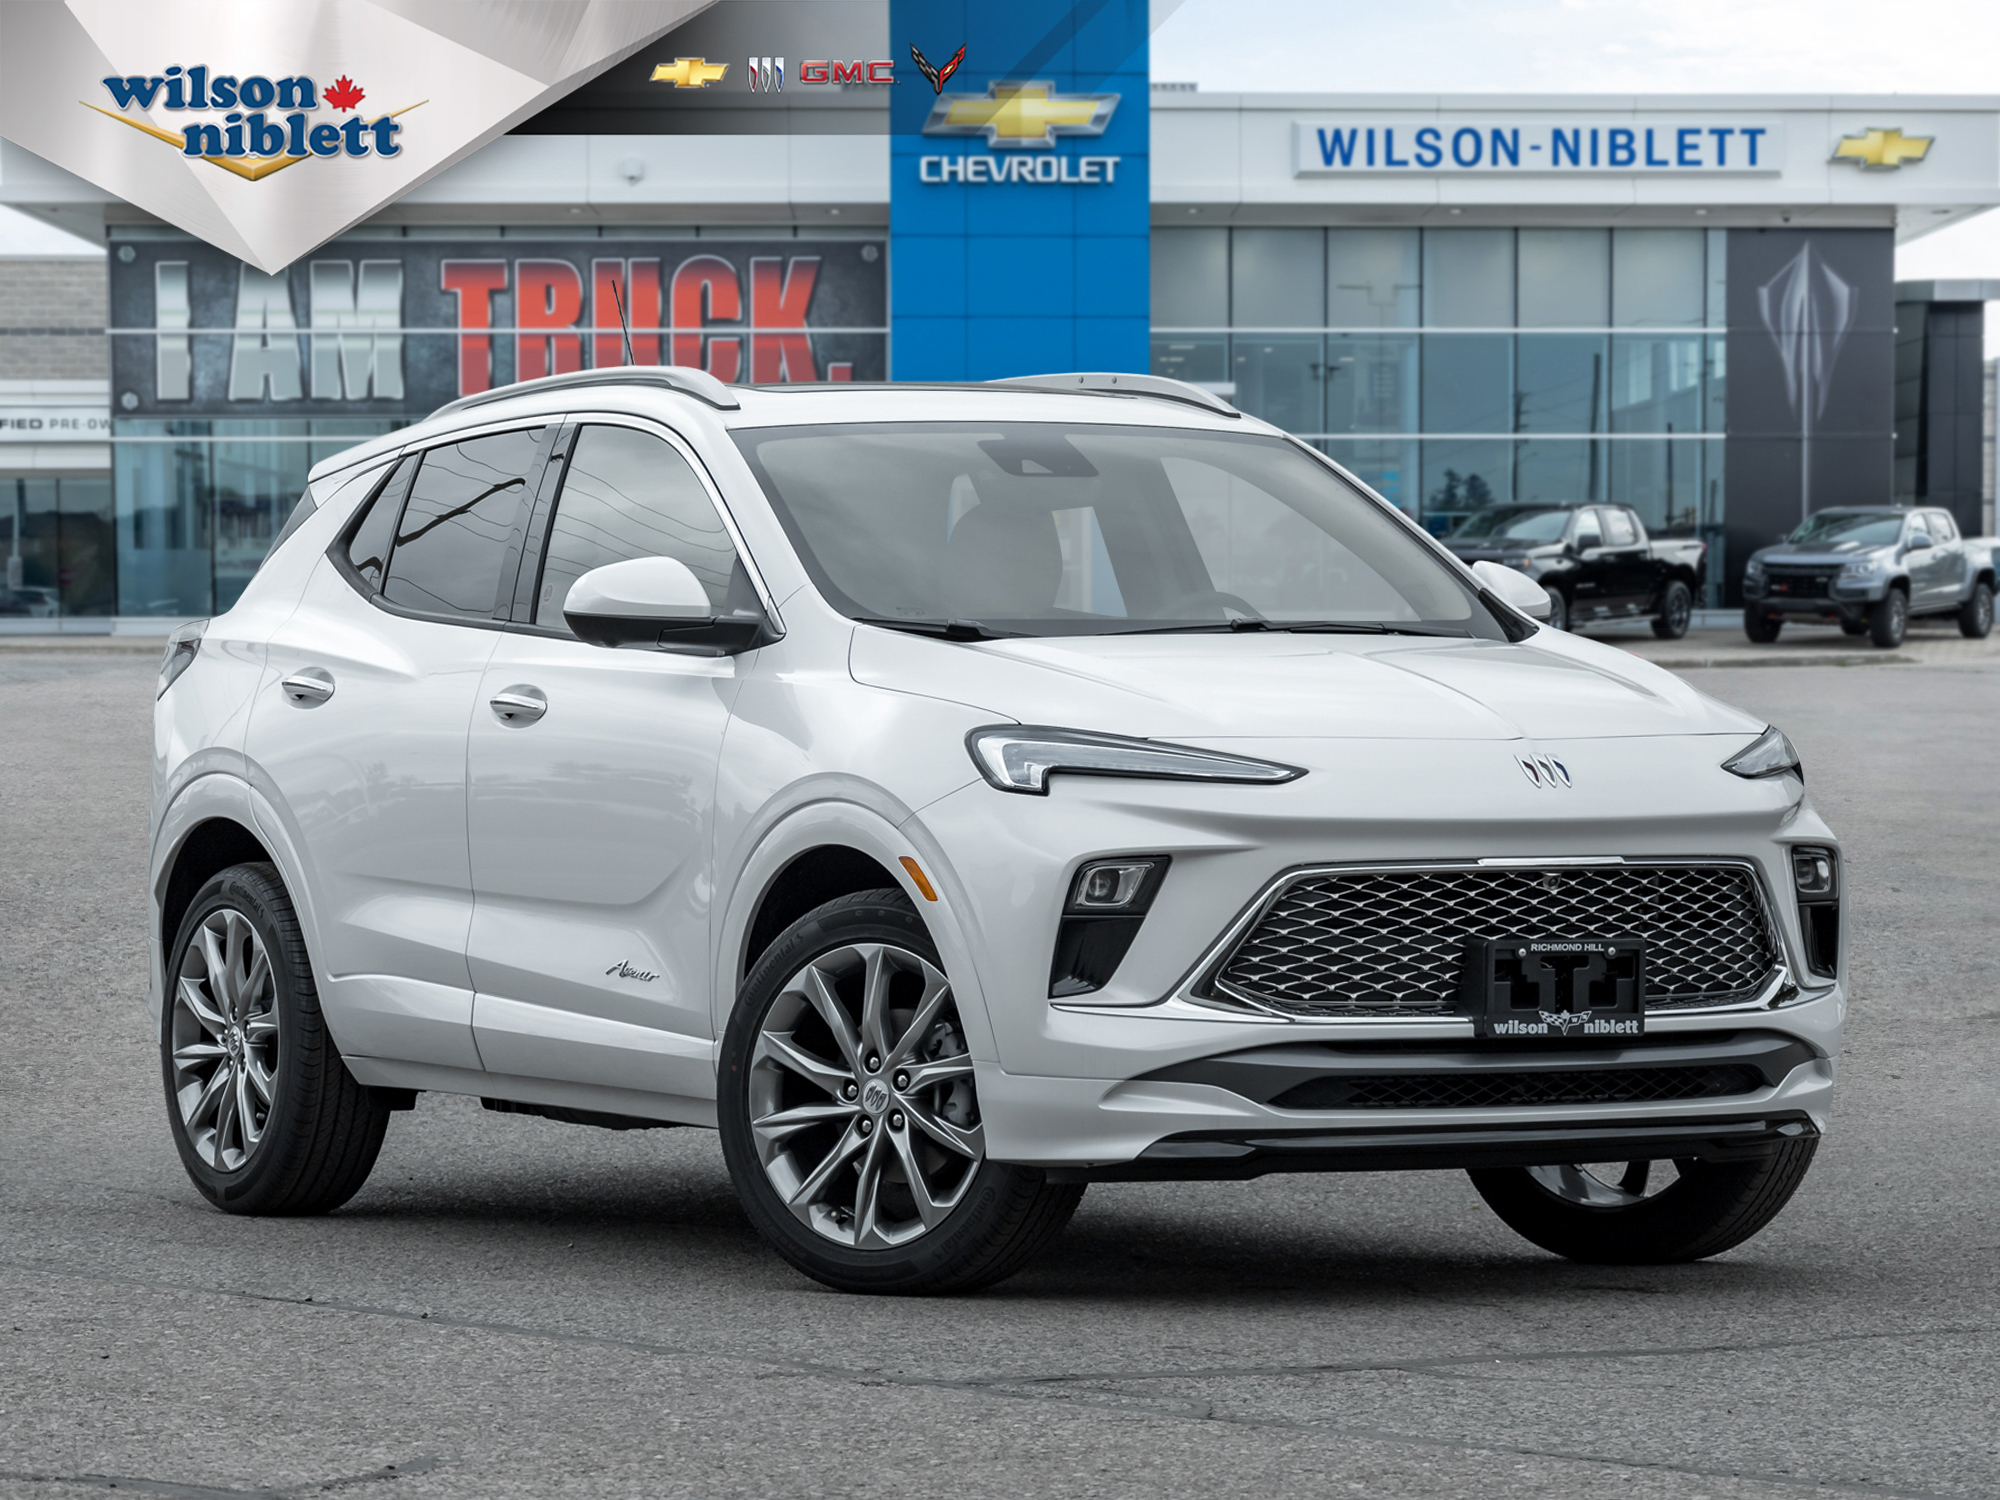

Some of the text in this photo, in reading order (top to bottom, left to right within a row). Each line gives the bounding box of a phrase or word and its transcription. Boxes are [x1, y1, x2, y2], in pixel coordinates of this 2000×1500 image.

[919, 155, 1121, 184] CHEVROLET
[155, 262, 190, 400] I
[228, 259, 404, 400] AM
[1530, 943, 1605, 952] RICHMOND HILL
[745, 938, 795, 1006] Continental
[1493, 1018, 1639, 1035] wilson niblett
